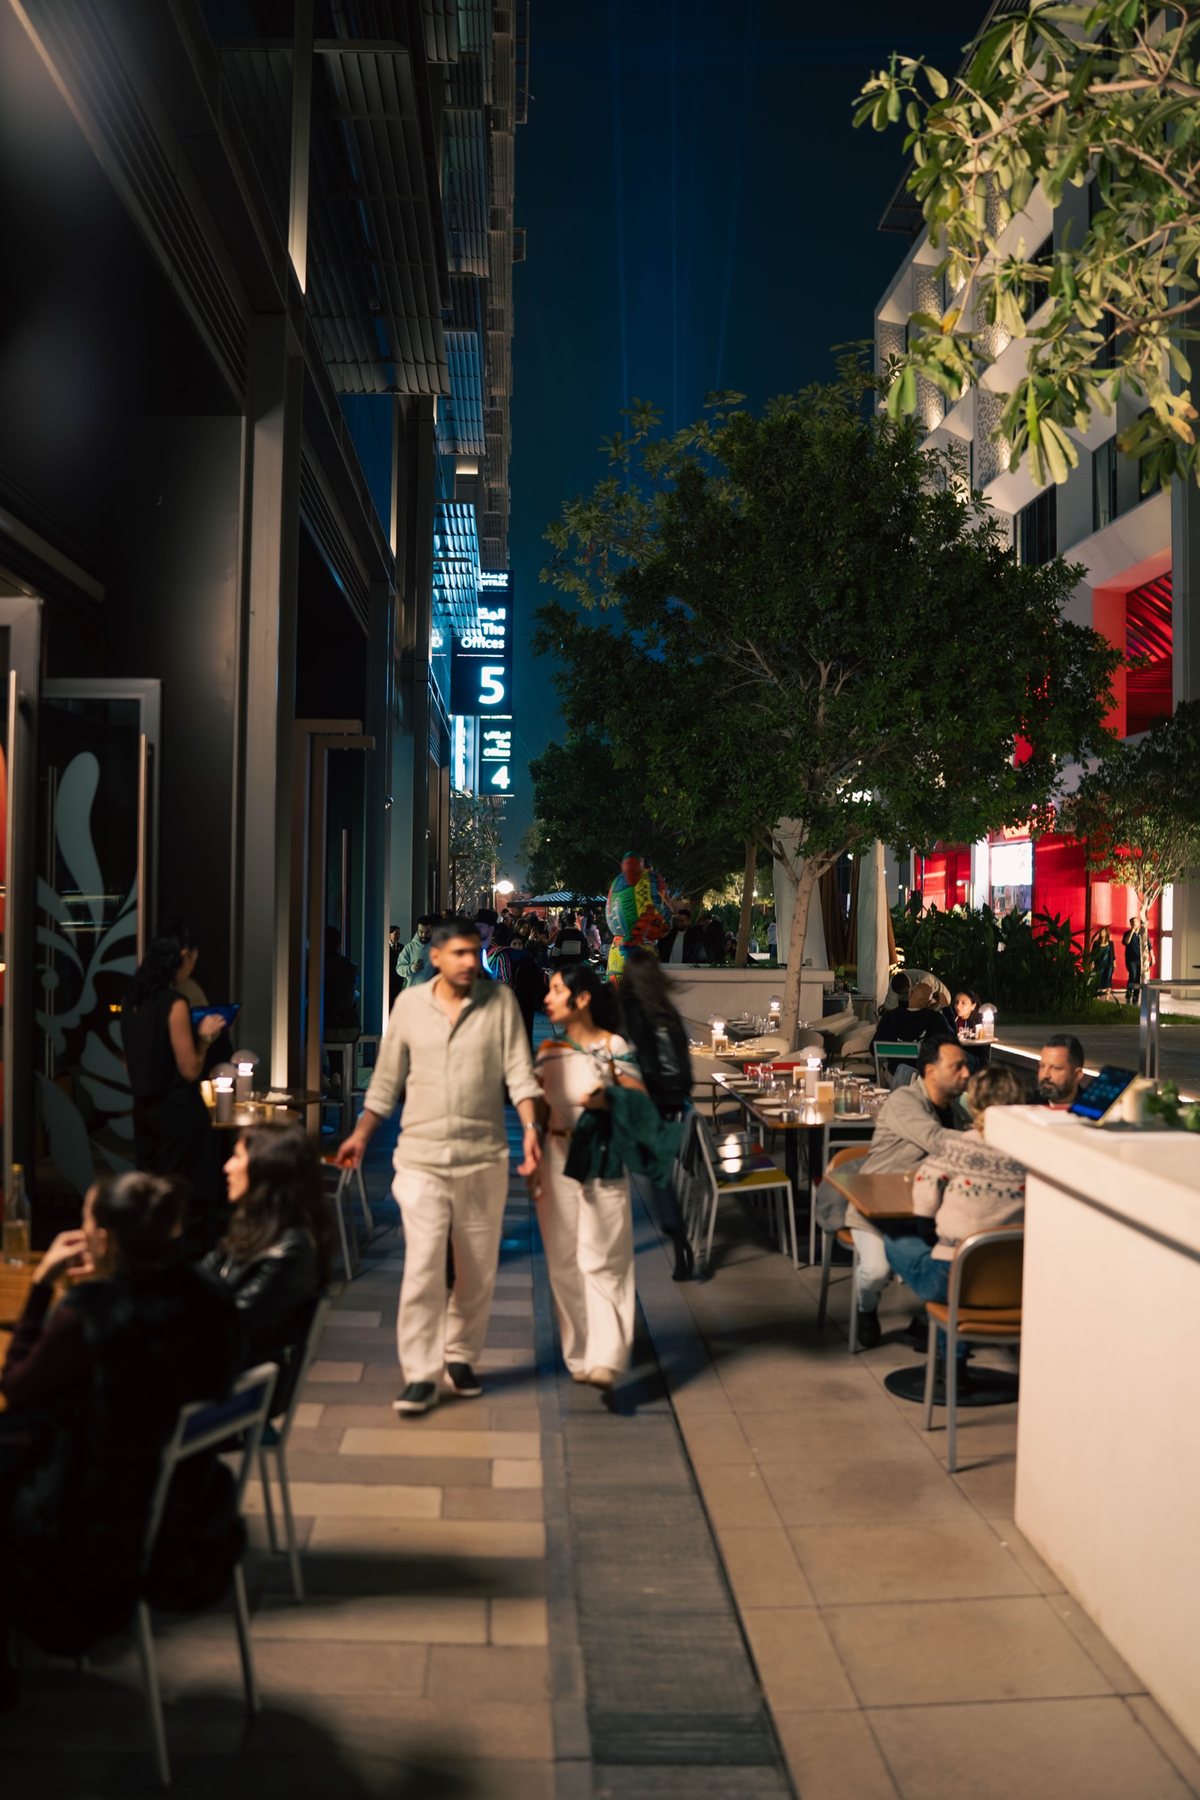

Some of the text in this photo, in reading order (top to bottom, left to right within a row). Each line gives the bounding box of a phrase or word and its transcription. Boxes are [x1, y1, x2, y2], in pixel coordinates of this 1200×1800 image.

[481, 622, 506, 636] The
[461, 636, 505, 649] Offices
[478, 666, 505, 705] 5
[491, 765, 511, 789] 4
